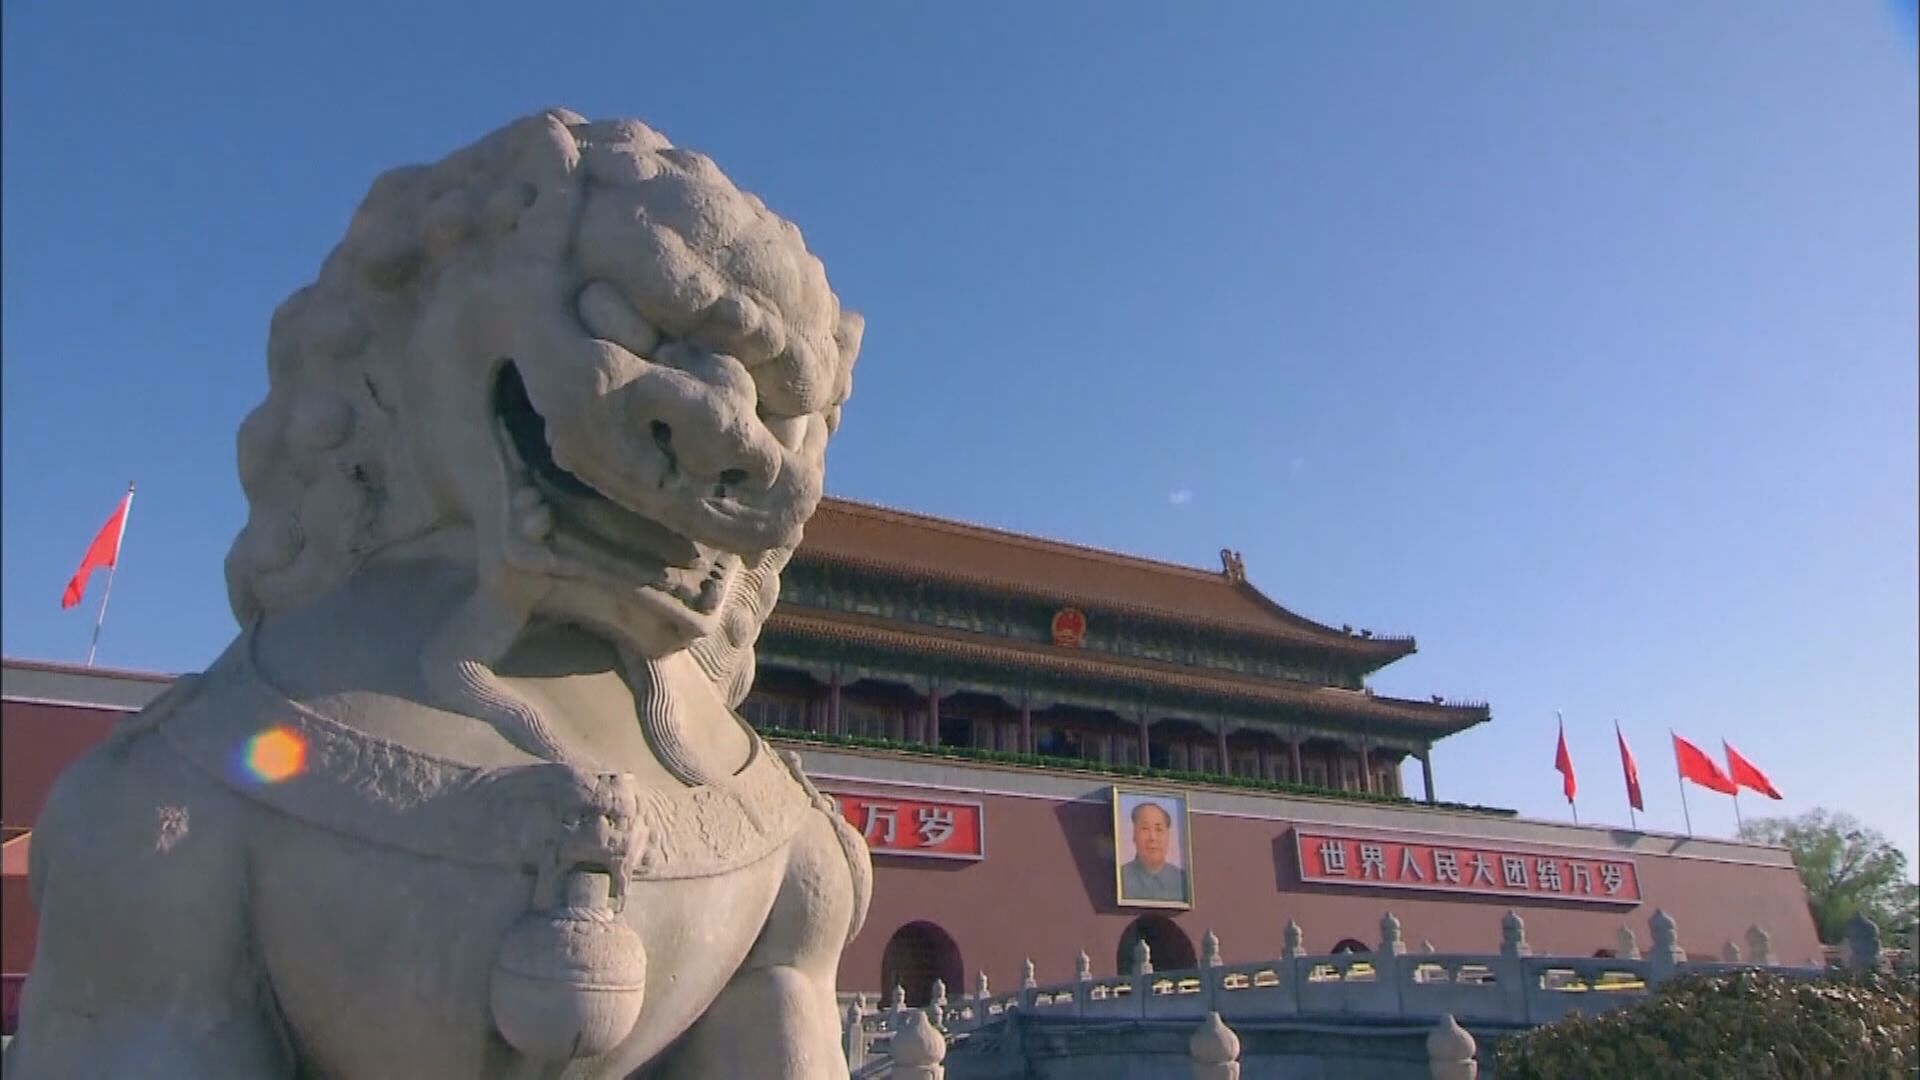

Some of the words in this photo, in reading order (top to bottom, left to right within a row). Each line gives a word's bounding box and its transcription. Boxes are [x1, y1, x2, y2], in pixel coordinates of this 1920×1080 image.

[861, 802, 953, 846] 万岁
[1320, 841, 1624, 896] 世界人民大团结万岁
